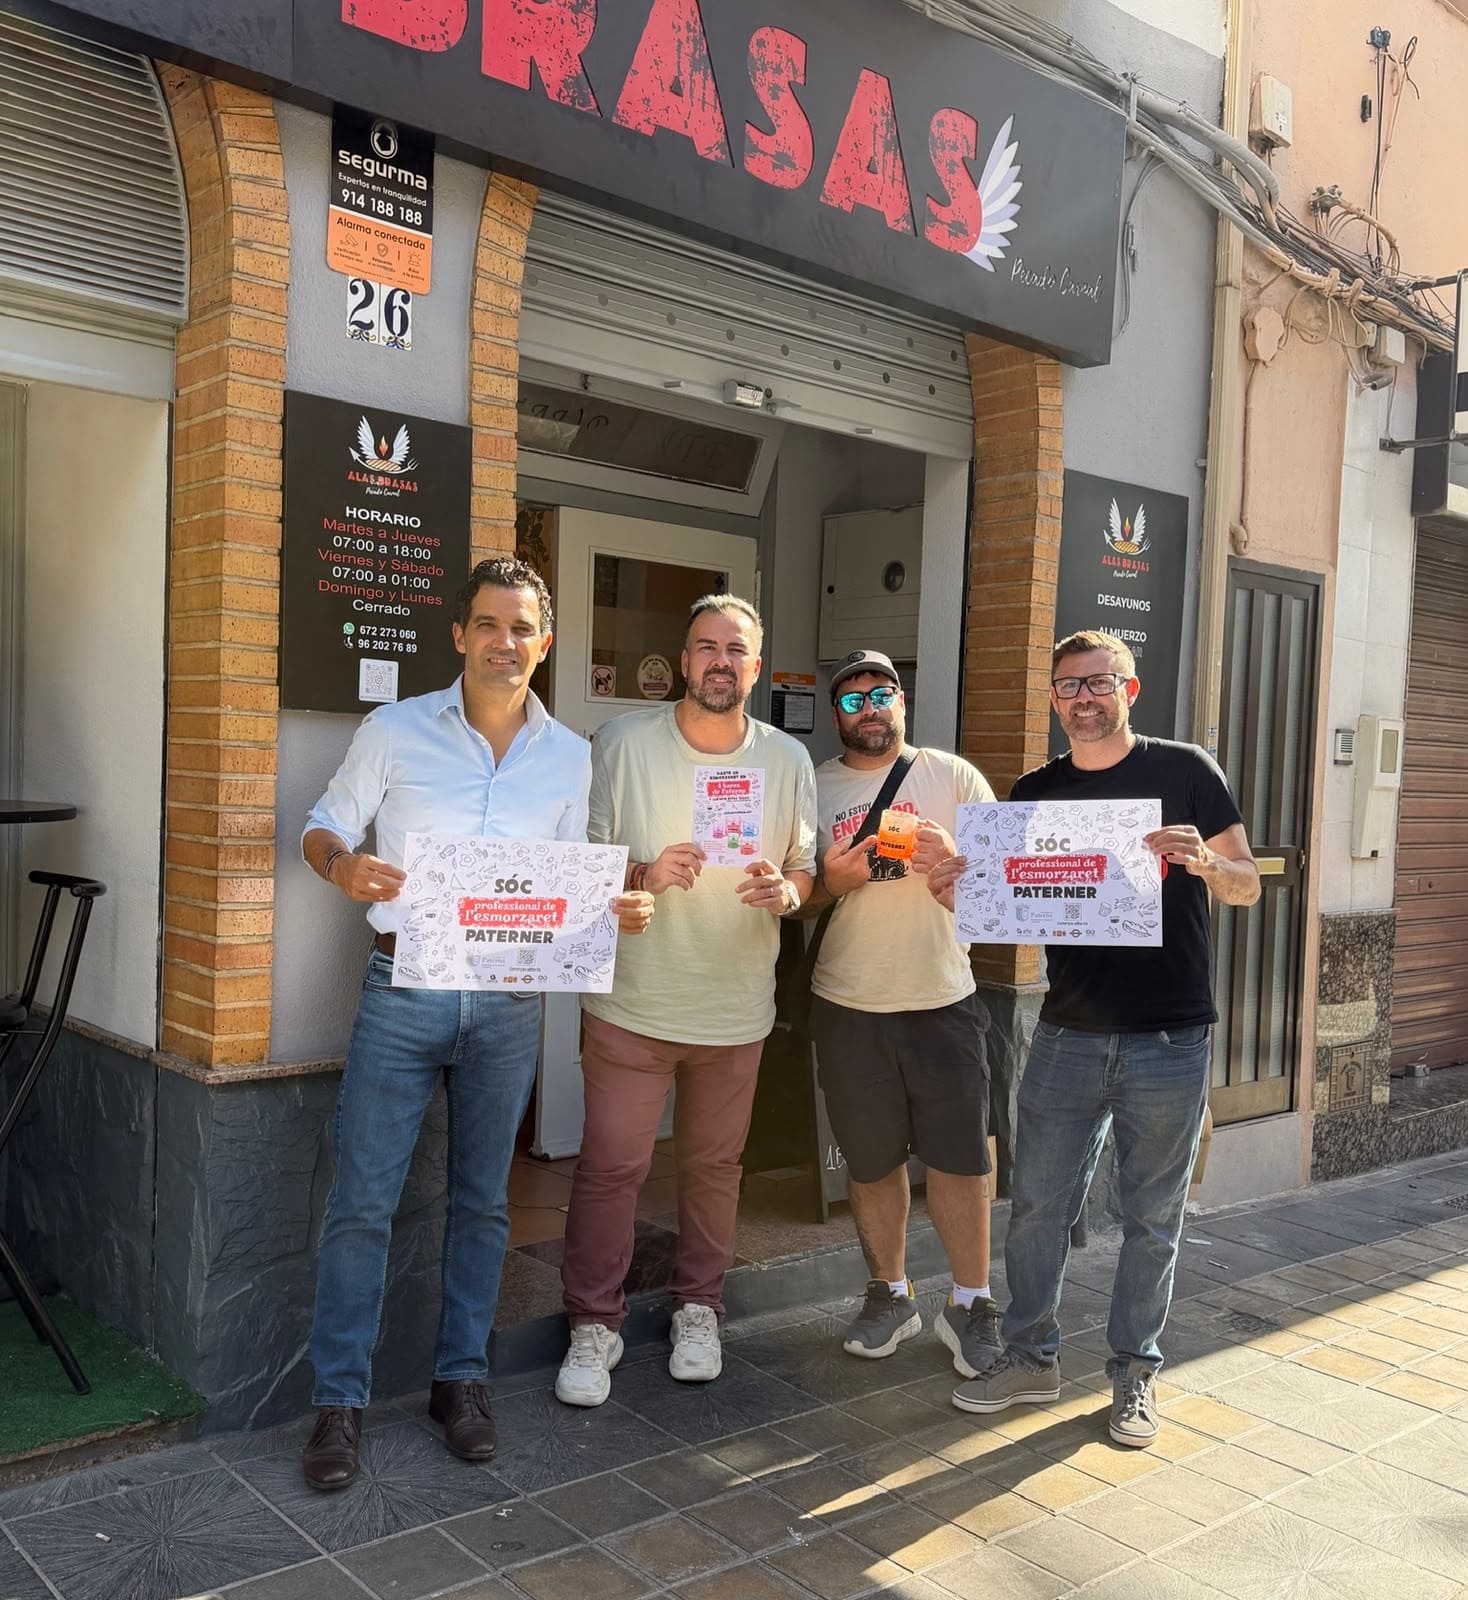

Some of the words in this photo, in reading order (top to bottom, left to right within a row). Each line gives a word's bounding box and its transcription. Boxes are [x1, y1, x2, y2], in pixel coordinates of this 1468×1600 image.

[341, 0, 983, 254] RASAS
[338, 150, 428, 190] segurma
[338, 172, 370, 190] Expertos
[371, 183, 382, 194] en
[382, 185, 428, 207] tranquilidad
[341, 189, 365, 208] 914
[371, 198, 394, 217] 188
[399, 206, 423, 226] 188
[336, 216, 371, 236] Alarma
[374, 230, 426, 251] conectada
[349, 278, 411, 337] 26
[348, 471, 376, 486] ALAS
[377, 475, 418, 492] BRASAS
[346, 506, 421, 529] HORARIO
[323, 518, 374, 538] Martes
[378, 528, 387, 539] a
[392, 529, 440, 548] Jueves
[333, 535, 373, 552] 07:00
[378, 544, 387, 554] a
[393, 545, 431, 561] 18:00
[318, 548, 374, 568] Viernes
[378, 559, 386, 571] y
[391, 556, 444, 577] Sábado
[332, 566, 373, 583] 07:00
[378, 575, 386, 584] a
[391, 575, 430, 590] 01:00
[318, 579, 384, 603] Domingo
[388, 592, 396, 602] y
[401, 591, 442, 606] Lunes
[1098, 593, 1150, 612] DESAYUNOS
[352, 600, 411, 616] Cerrado
[359, 625, 377, 636] 672
[379, 626, 397, 638] 273
[399, 628, 416, 640] 060
[358, 638, 370, 650] 96
[372, 640, 390, 651] 202
[392, 642, 404, 652] 76
[406, 642, 418, 654] 89
[835, 811, 846, 823] NO
[848, 802, 872, 817] ESTOY
[1035, 833, 1070, 852] SÓC
[1012, 868, 1098, 880] l'esmorzaret
[1018, 859, 1081, 870] professional
[1084, 858, 1096, 868] de
[494, 874, 532, 894] SÓC
[1013, 886, 1097, 899] PATERNER
[465, 909, 558, 923] l'esmorzaret
[474, 900, 541, 912] professional
[543, 902, 556, 911] de
[465, 929, 554, 944] PATERNER
